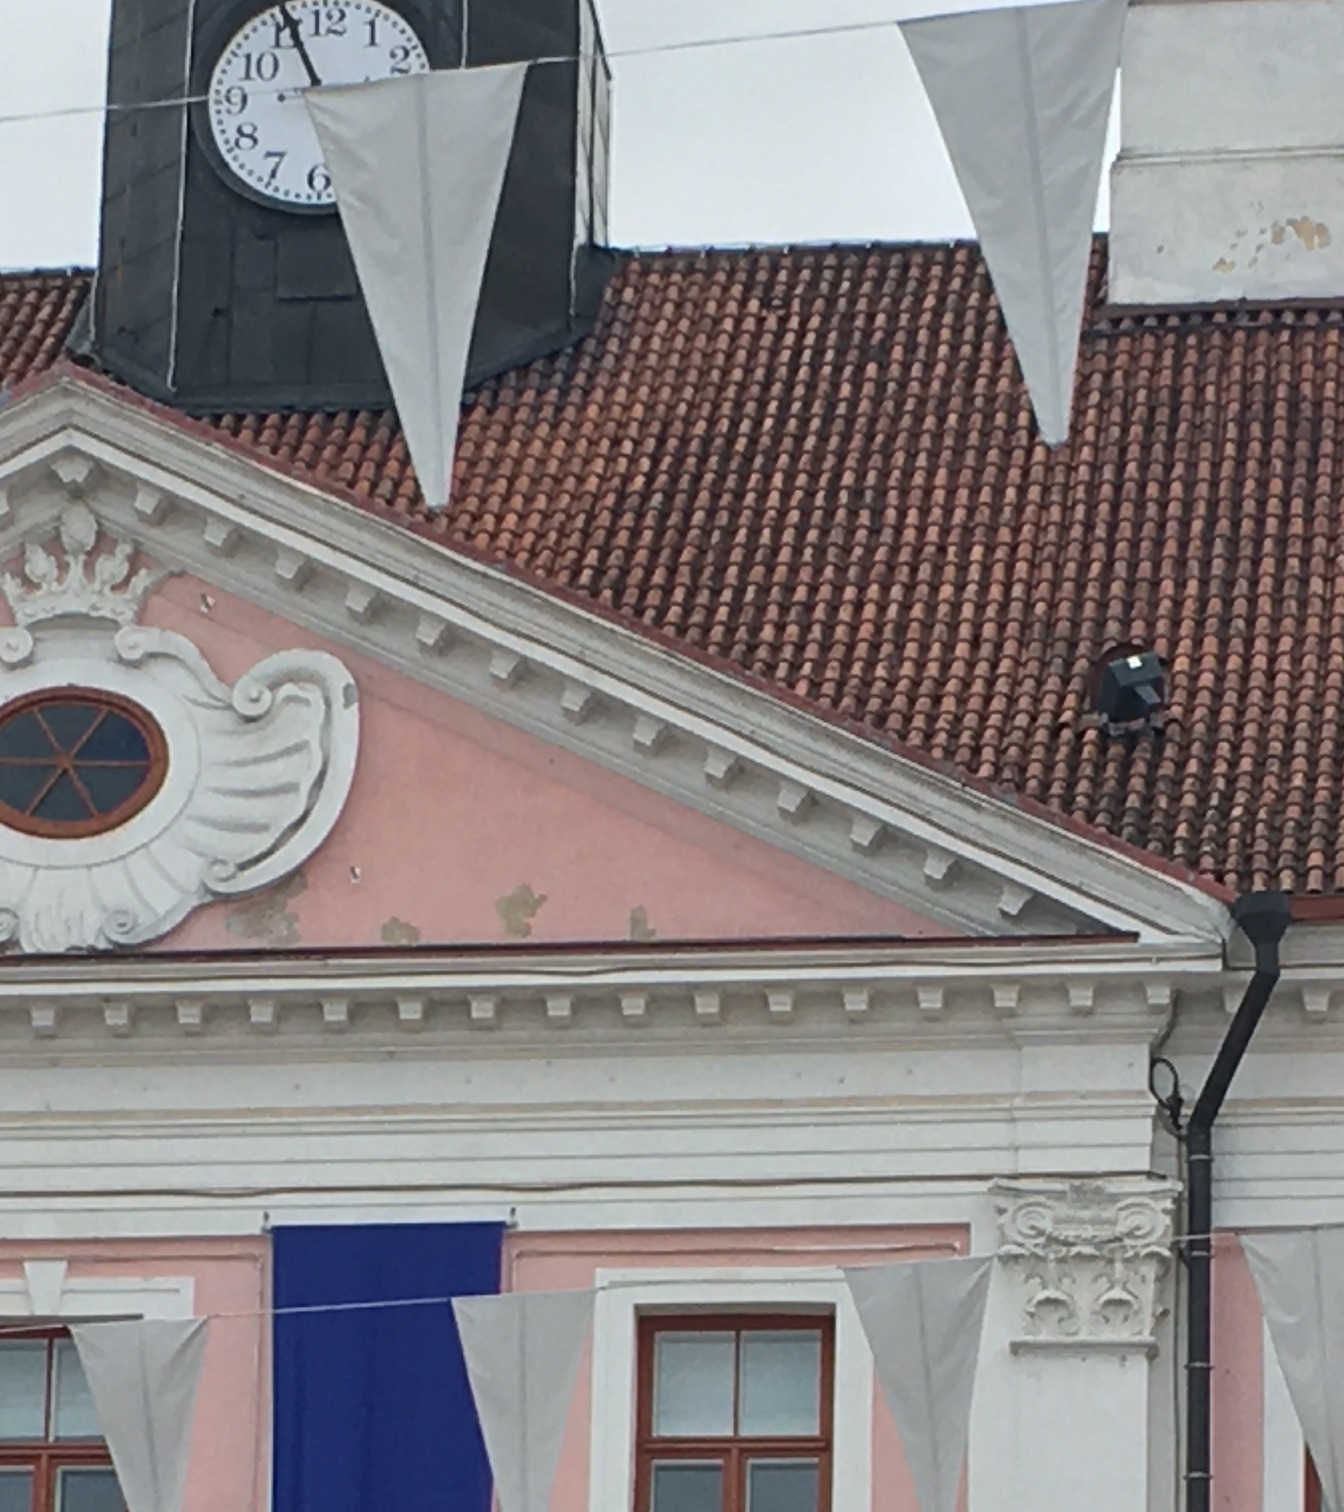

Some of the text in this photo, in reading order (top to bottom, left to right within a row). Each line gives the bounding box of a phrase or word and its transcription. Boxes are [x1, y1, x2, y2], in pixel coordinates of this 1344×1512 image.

[309, 8, 347, 37] 12
[363, 18, 380, 47] 1
[238, 52, 280, 81] 10
[390, 46, 412, 74] 2
[225, 85, 248, 116] 9
[234, 122, 259, 150] 8
[264, 151, 287, 181] 7
[307, 164, 331, 194] 6
